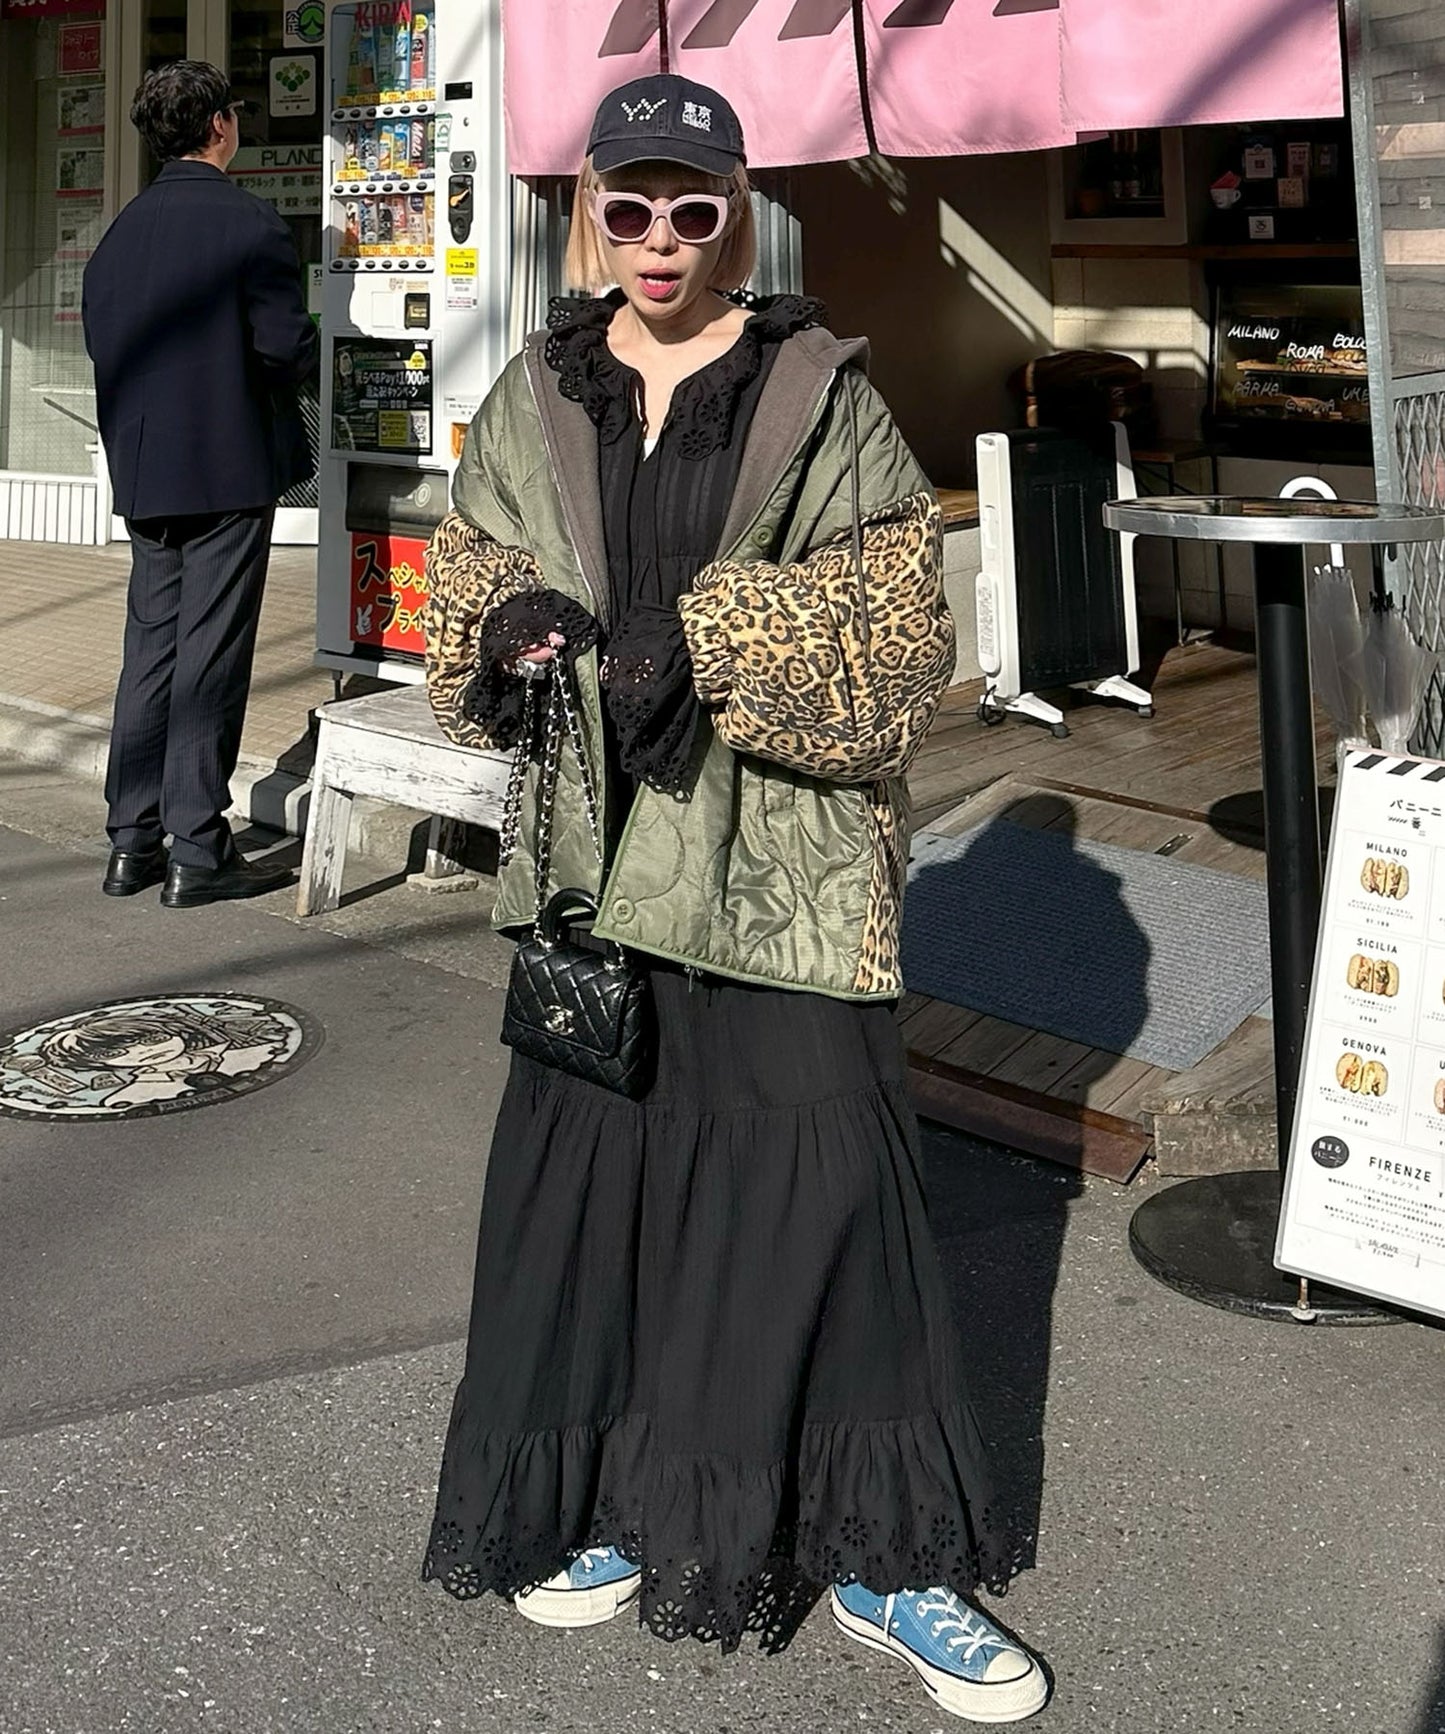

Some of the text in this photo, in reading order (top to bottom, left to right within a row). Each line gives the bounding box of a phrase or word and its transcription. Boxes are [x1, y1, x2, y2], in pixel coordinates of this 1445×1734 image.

[356, 0, 411, 26] KIRIN
[1227, 324, 1280, 341] MILANO
[1286, 342, 1325, 360] ROMA
[1389, 799, 1442, 817] パニーニ
[1366, 842, 1408, 858] MILANO
[1356, 937, 1398, 954] SICILIA
[1342, 1037, 1387, 1056] GENOVA
[1368, 1156, 1433, 1183] FIRENZE
